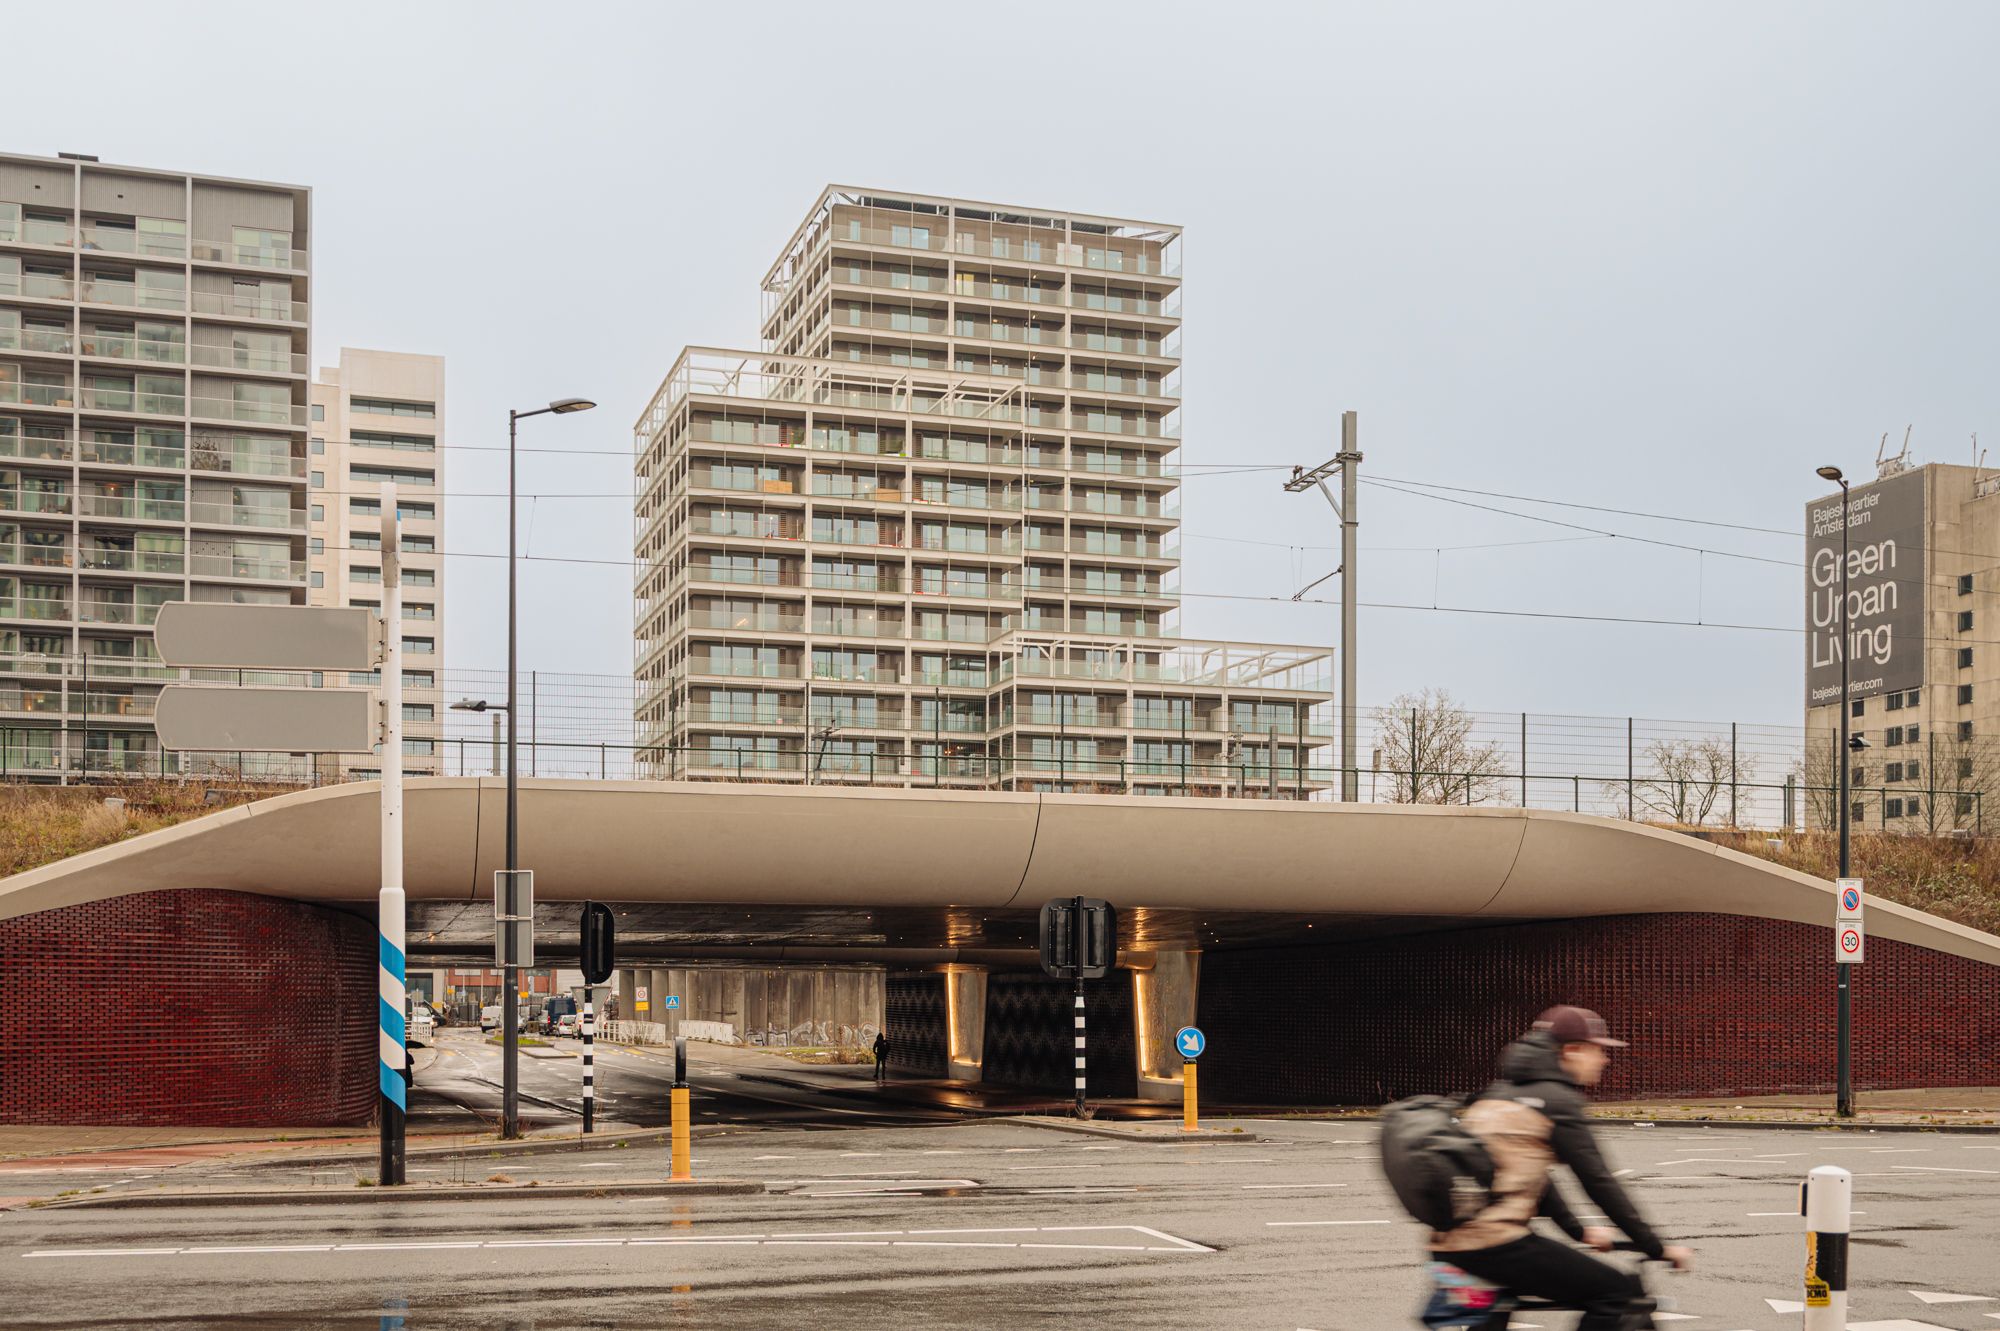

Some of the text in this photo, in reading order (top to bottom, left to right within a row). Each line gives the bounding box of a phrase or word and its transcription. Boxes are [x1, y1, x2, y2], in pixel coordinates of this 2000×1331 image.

[1813, 511, 1871, 538] Amstedam
[1812, 539, 1896, 587] Green
[1812, 581, 1897, 627] Urban
[1844, 936, 1856, 947] 30
